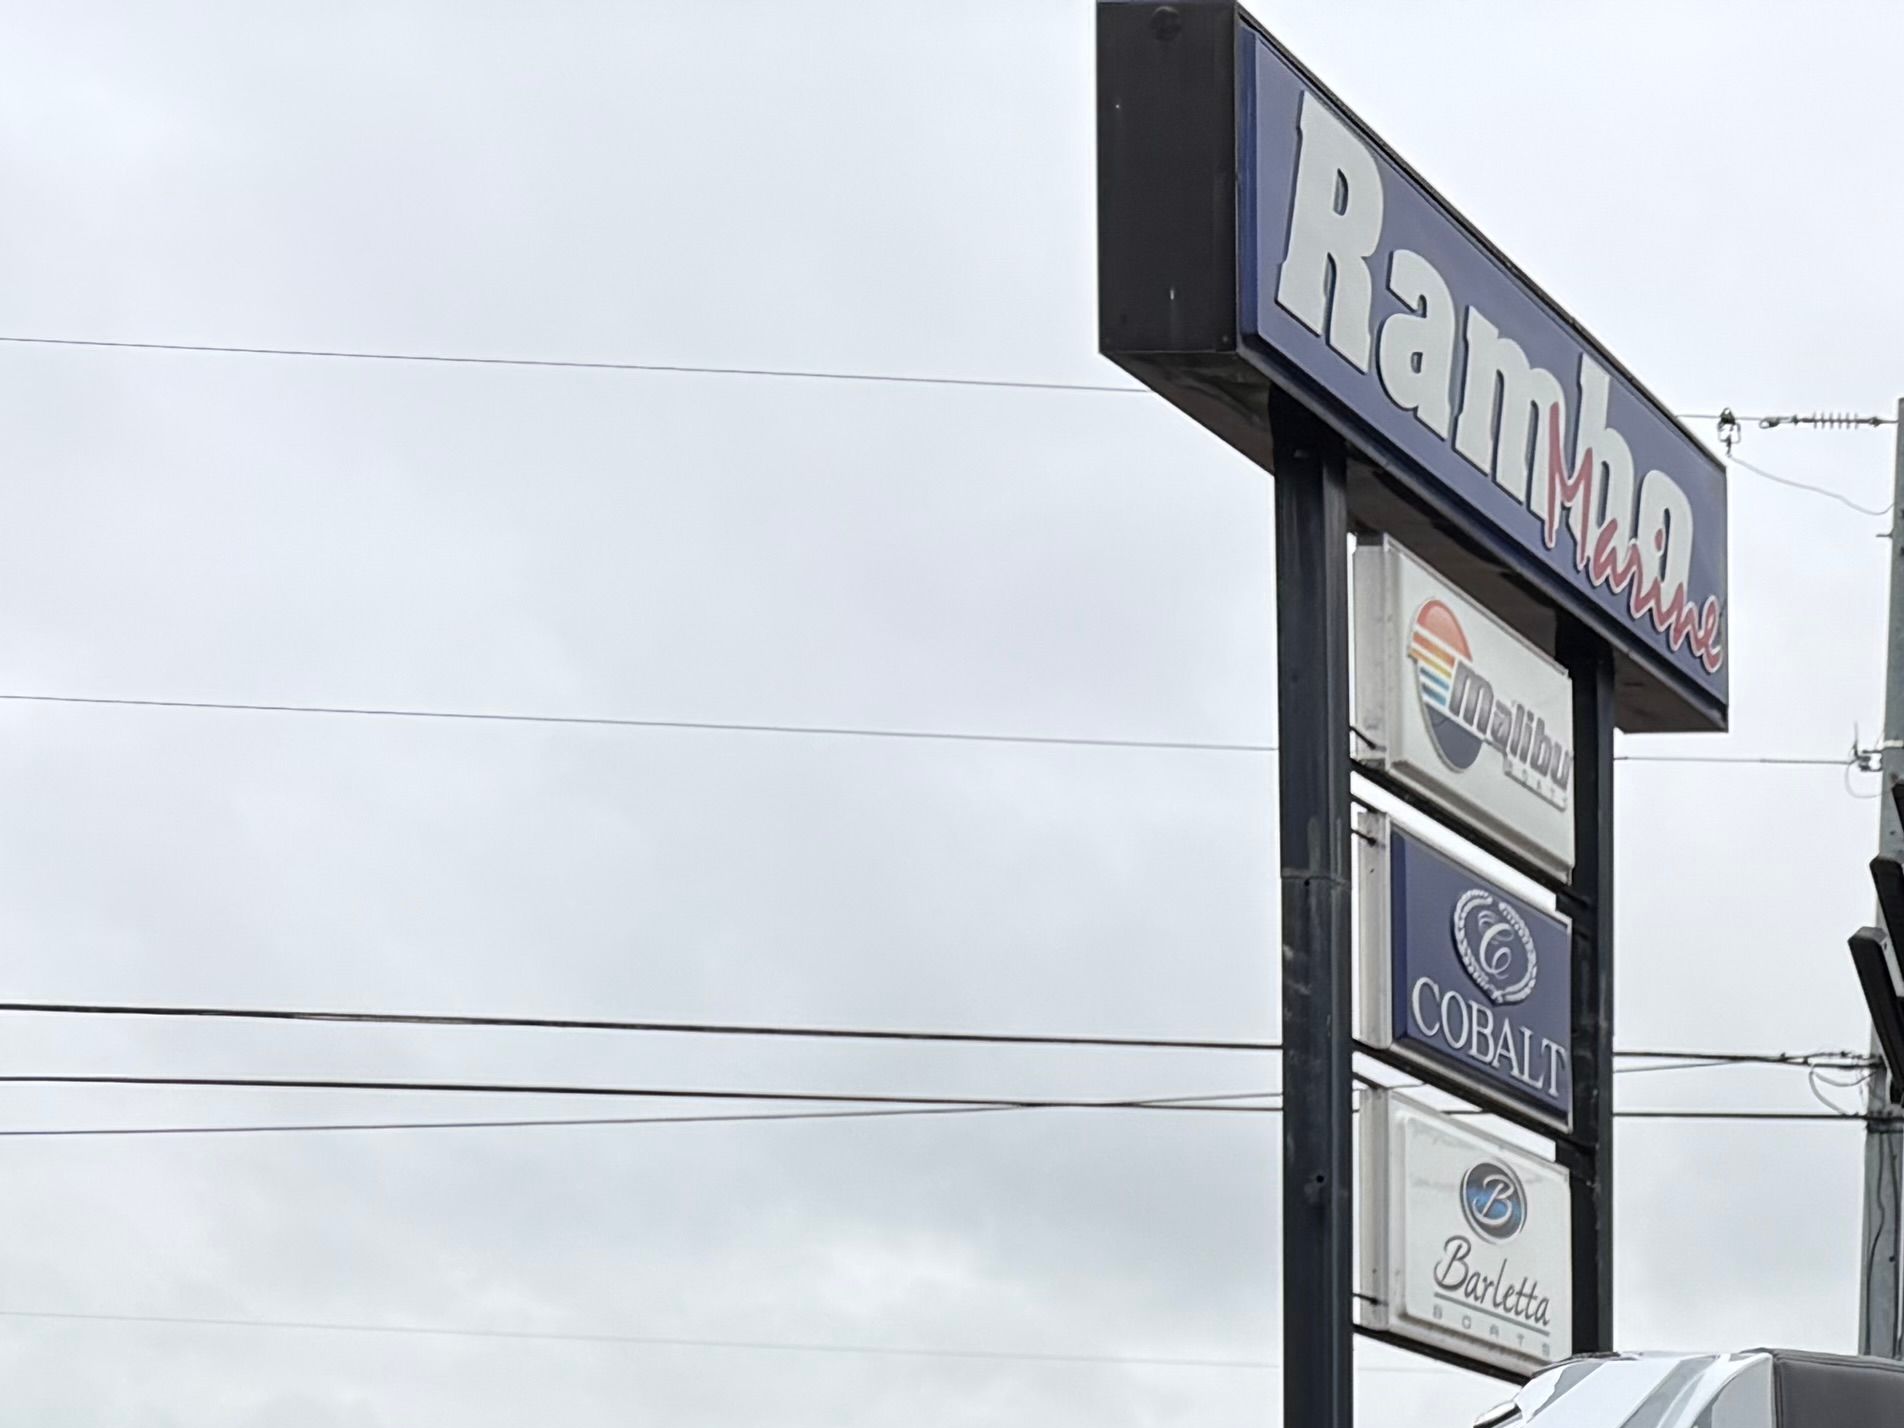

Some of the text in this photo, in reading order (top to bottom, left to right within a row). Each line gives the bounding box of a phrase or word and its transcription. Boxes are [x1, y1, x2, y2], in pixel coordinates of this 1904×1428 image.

[1276, 90, 1693, 600] Rambo
[1546, 400, 1724, 674] Marine
[1448, 658, 1571, 792] Malibu
[1412, 976, 1567, 1098] COBALT
[1434, 1235, 1550, 1326] Barletta
